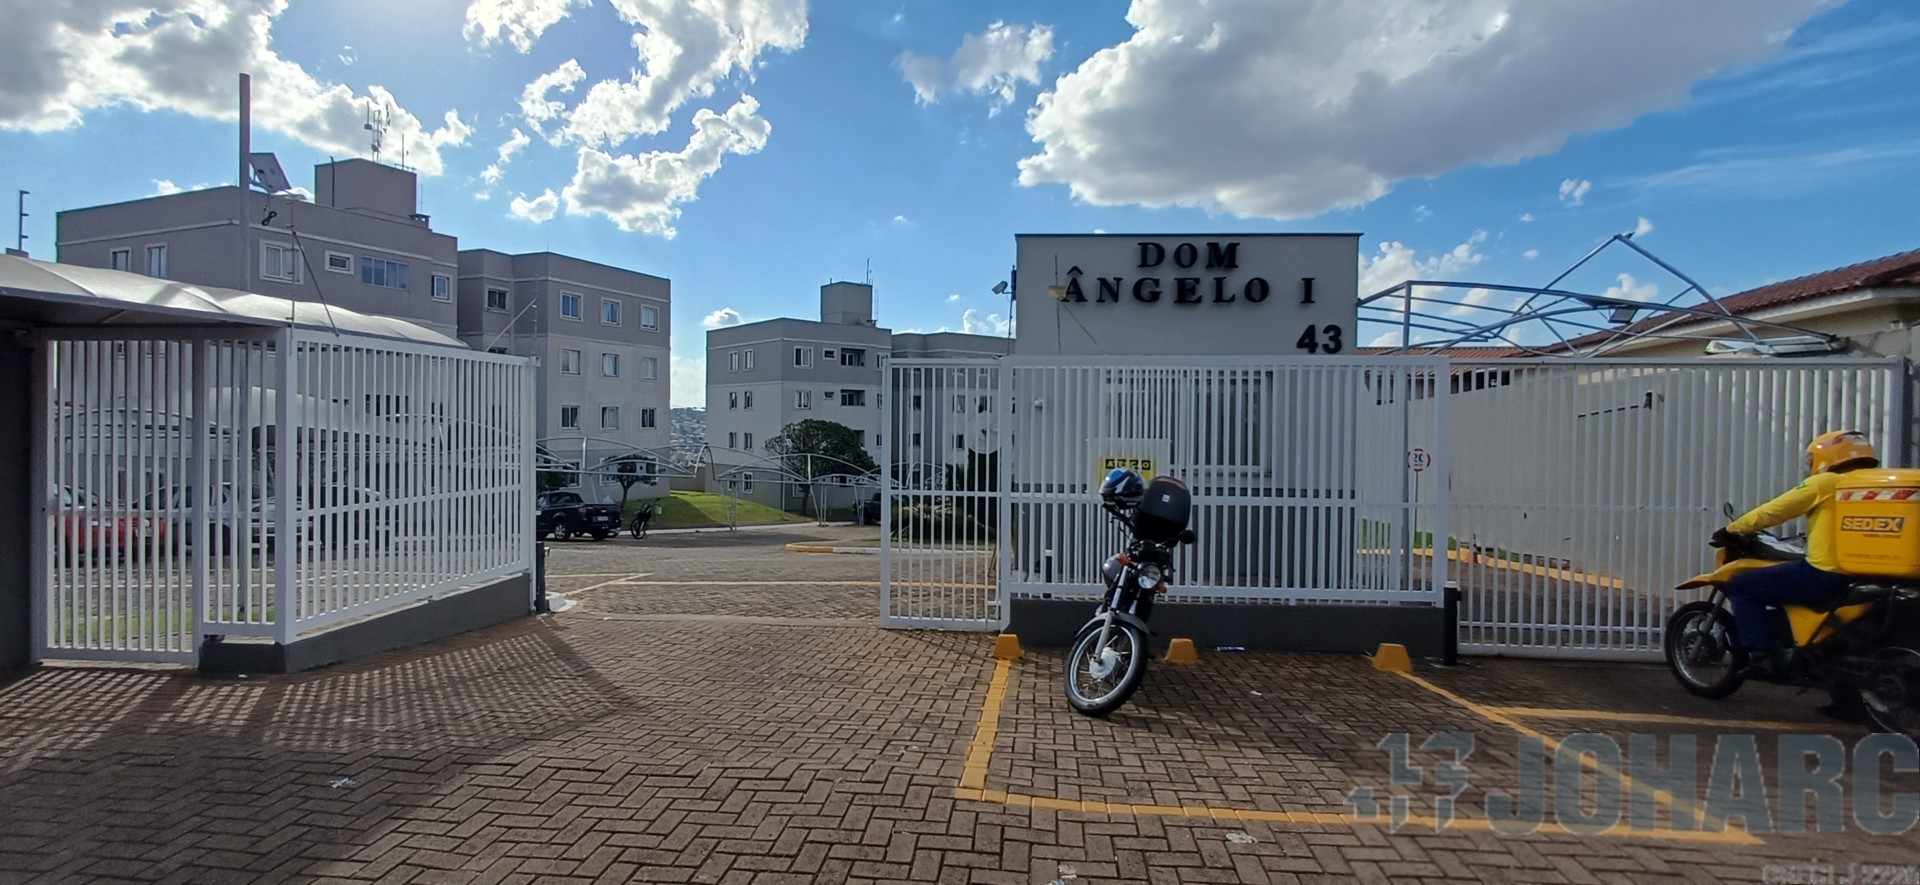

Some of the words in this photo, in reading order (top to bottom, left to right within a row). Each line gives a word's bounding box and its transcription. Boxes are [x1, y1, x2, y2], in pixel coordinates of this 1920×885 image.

[1137, 242, 1240, 268] DOM
[1061, 266, 1270, 303] ÂNGELO
[1300, 277, 1316, 304] I
[1296, 324, 1343, 354] 43
[1842, 517, 1903, 532] SEDEX
